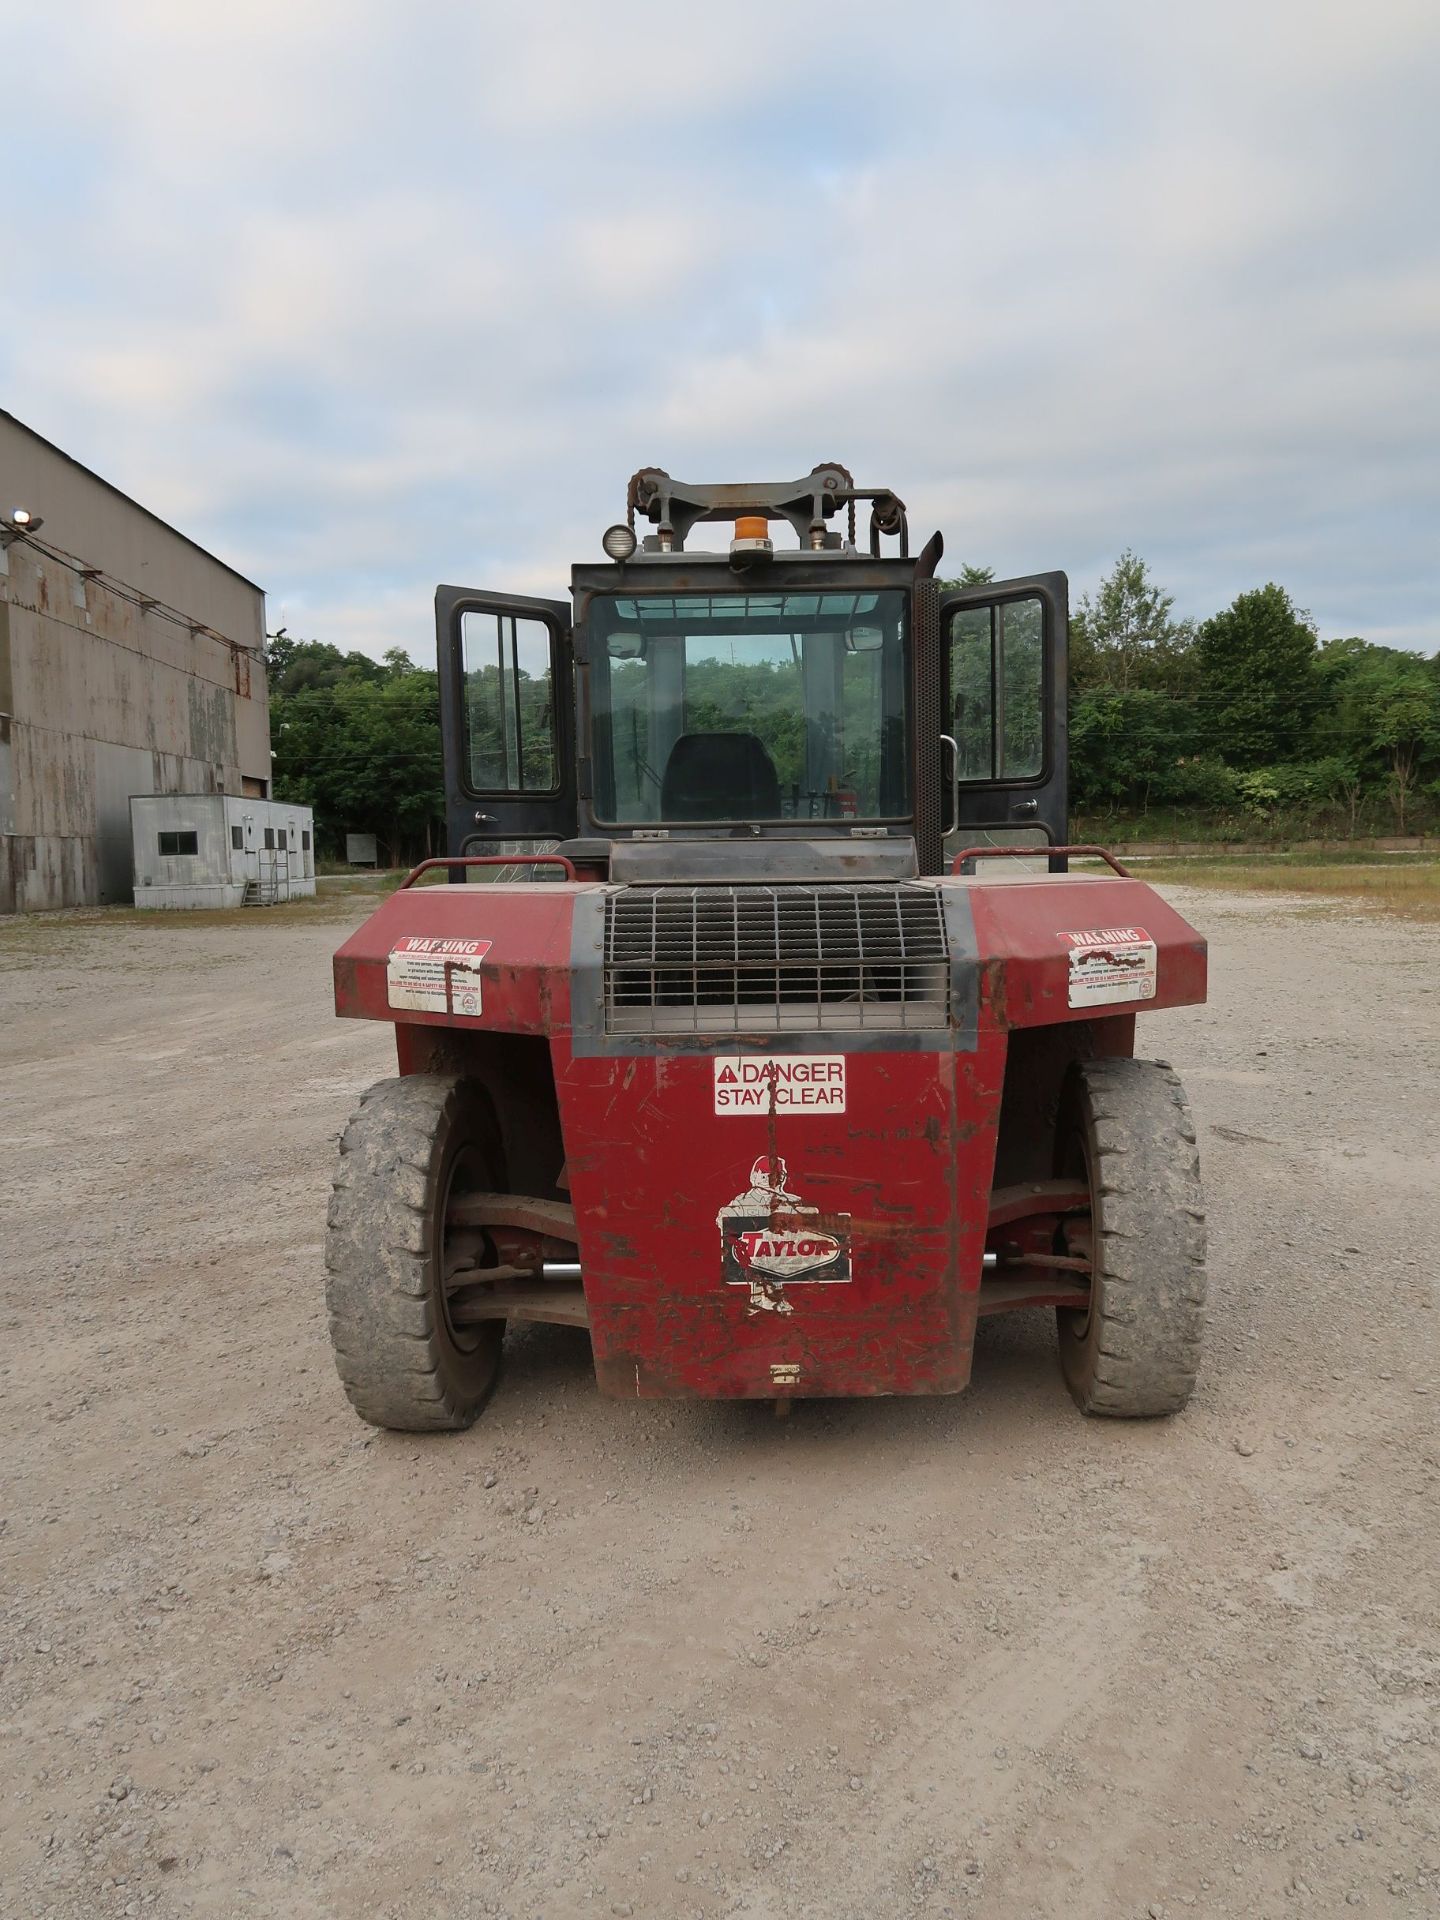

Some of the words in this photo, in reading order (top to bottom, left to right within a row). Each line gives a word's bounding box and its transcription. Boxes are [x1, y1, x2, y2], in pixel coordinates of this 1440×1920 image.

[743, 1063, 843, 1083] DANGER
[717, 1089, 765, 1105] STAY
[775, 1087, 844, 1105] CLEAR
[742, 1232, 830, 1257] TAYLOR
